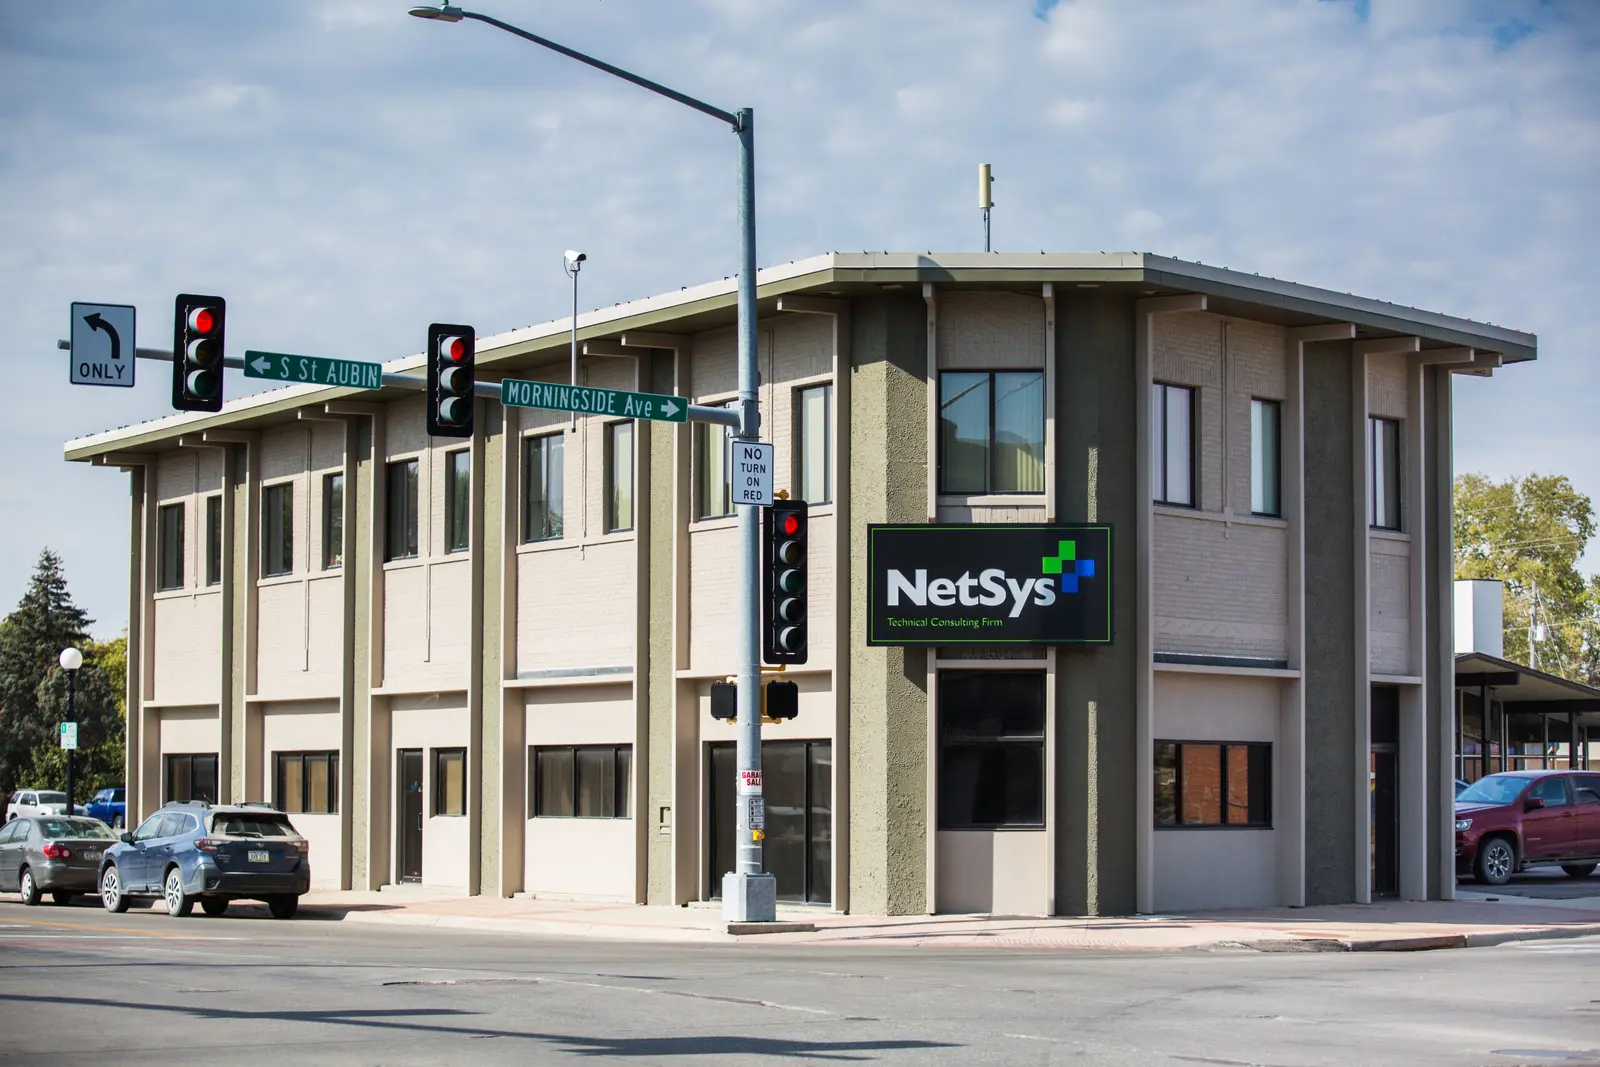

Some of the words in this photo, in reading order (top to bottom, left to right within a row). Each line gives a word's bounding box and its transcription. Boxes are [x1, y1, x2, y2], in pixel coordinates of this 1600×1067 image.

[79, 362, 126, 380] ONLY
[279, 356, 290, 378] S
[299, 358, 317, 381] St
[326, 361, 378, 388] AUBIN
[507, 381, 616, 414] MORNINGSIDE
[624, 394, 653, 418] Ave
[744, 447, 763, 460] NO
[740, 462, 766, 474] TURN
[746, 476, 760, 487] ON
[743, 489, 763, 501] RED
[886, 568, 1056, 618] NetSys
[886, 617, 928, 627] Technical
[930, 617, 979, 629] Consulting
[981, 617, 1003, 627] Firm
